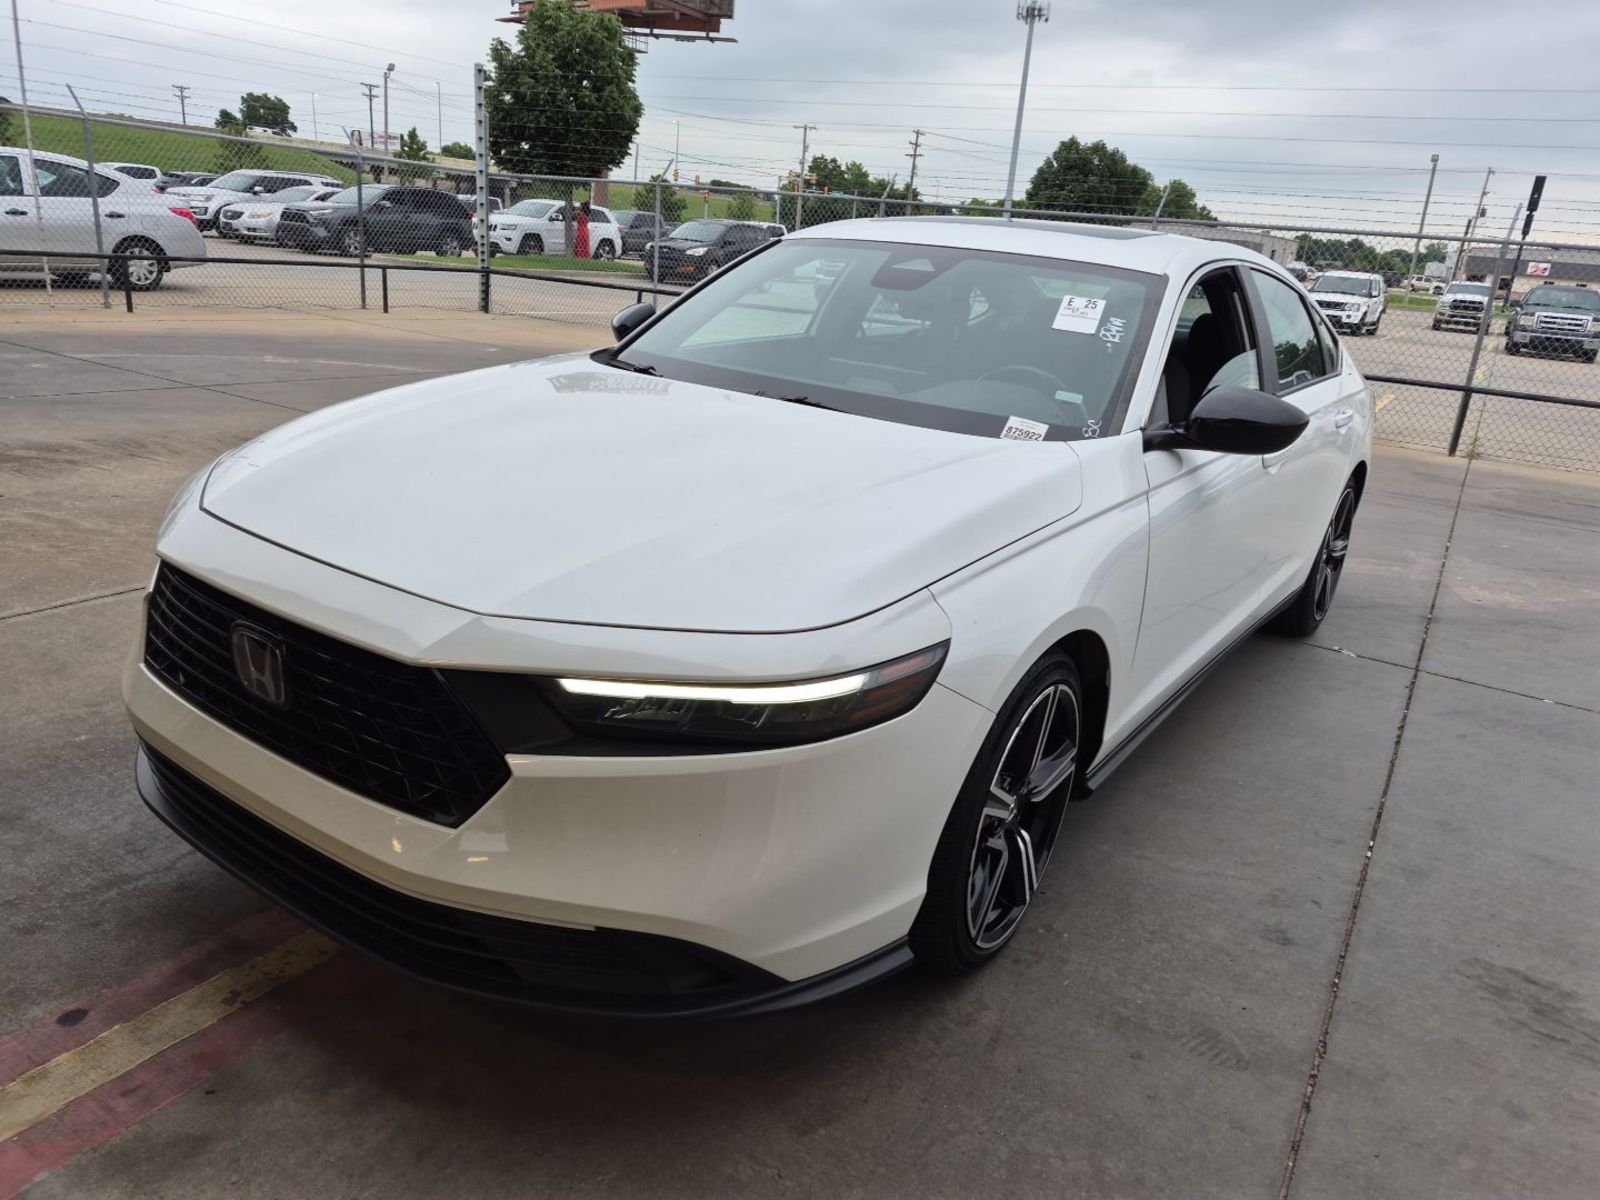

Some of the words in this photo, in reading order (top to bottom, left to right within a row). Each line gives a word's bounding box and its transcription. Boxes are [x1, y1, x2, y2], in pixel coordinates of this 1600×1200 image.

[1067, 297, 1075, 307] E
[1084, 299, 1099, 310] 25
[1005, 426, 1043, 441] 875922
